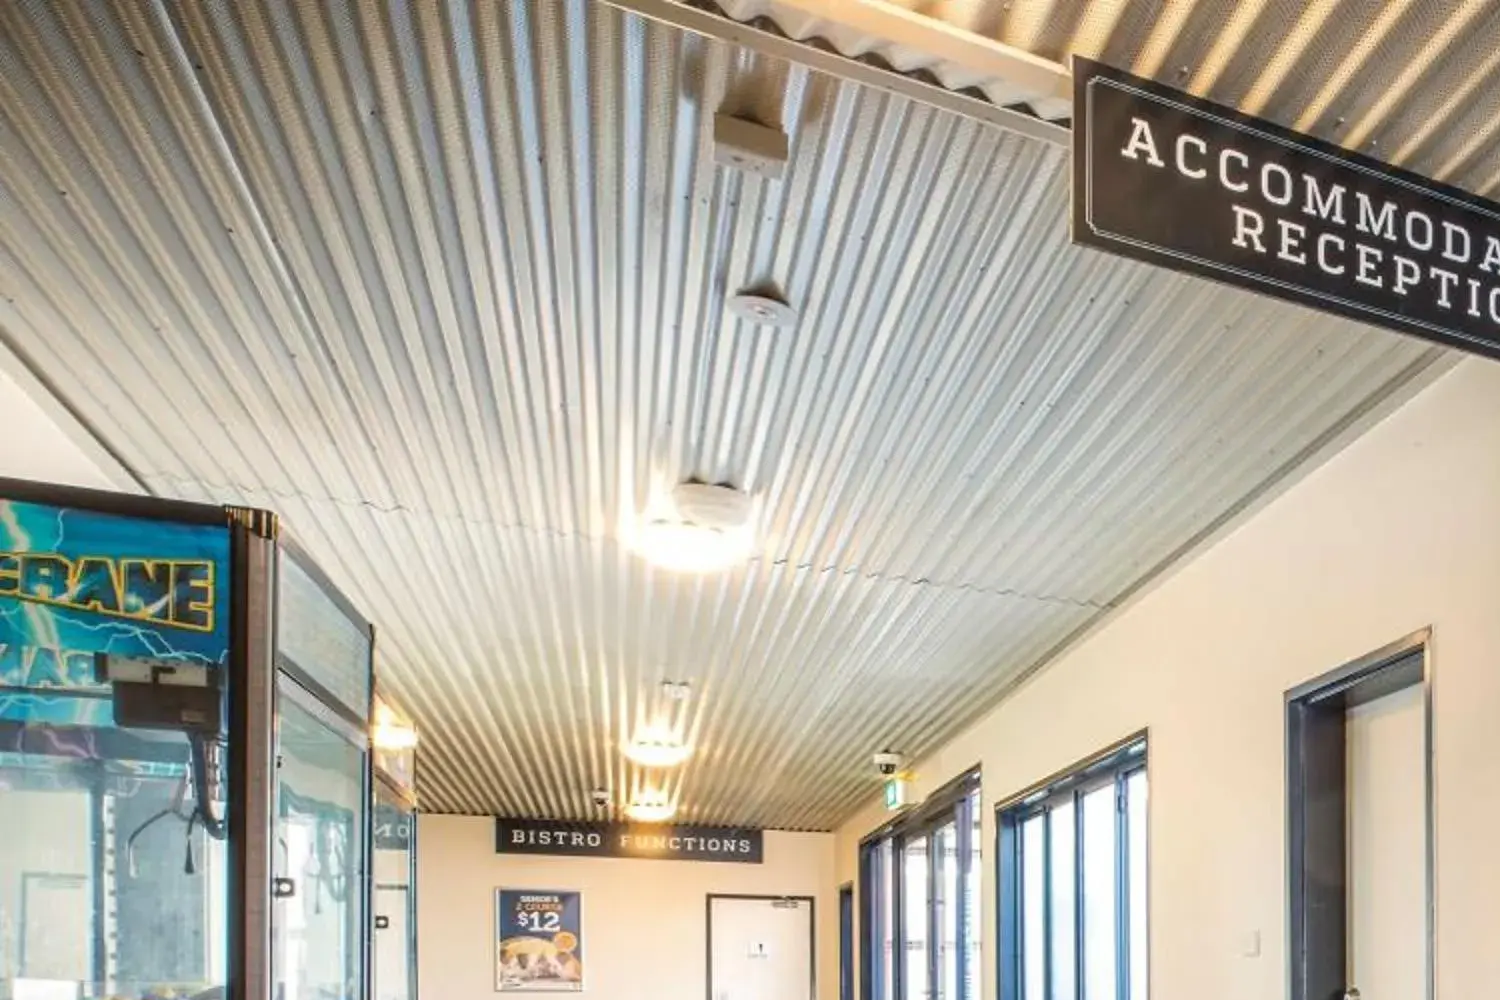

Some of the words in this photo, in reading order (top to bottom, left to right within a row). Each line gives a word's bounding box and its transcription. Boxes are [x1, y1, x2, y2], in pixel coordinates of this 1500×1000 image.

[511, 828, 601, 847] BISTRO
[620, 834, 751, 854] FUNCTIONS
[518, 911, 560, 932] $12
